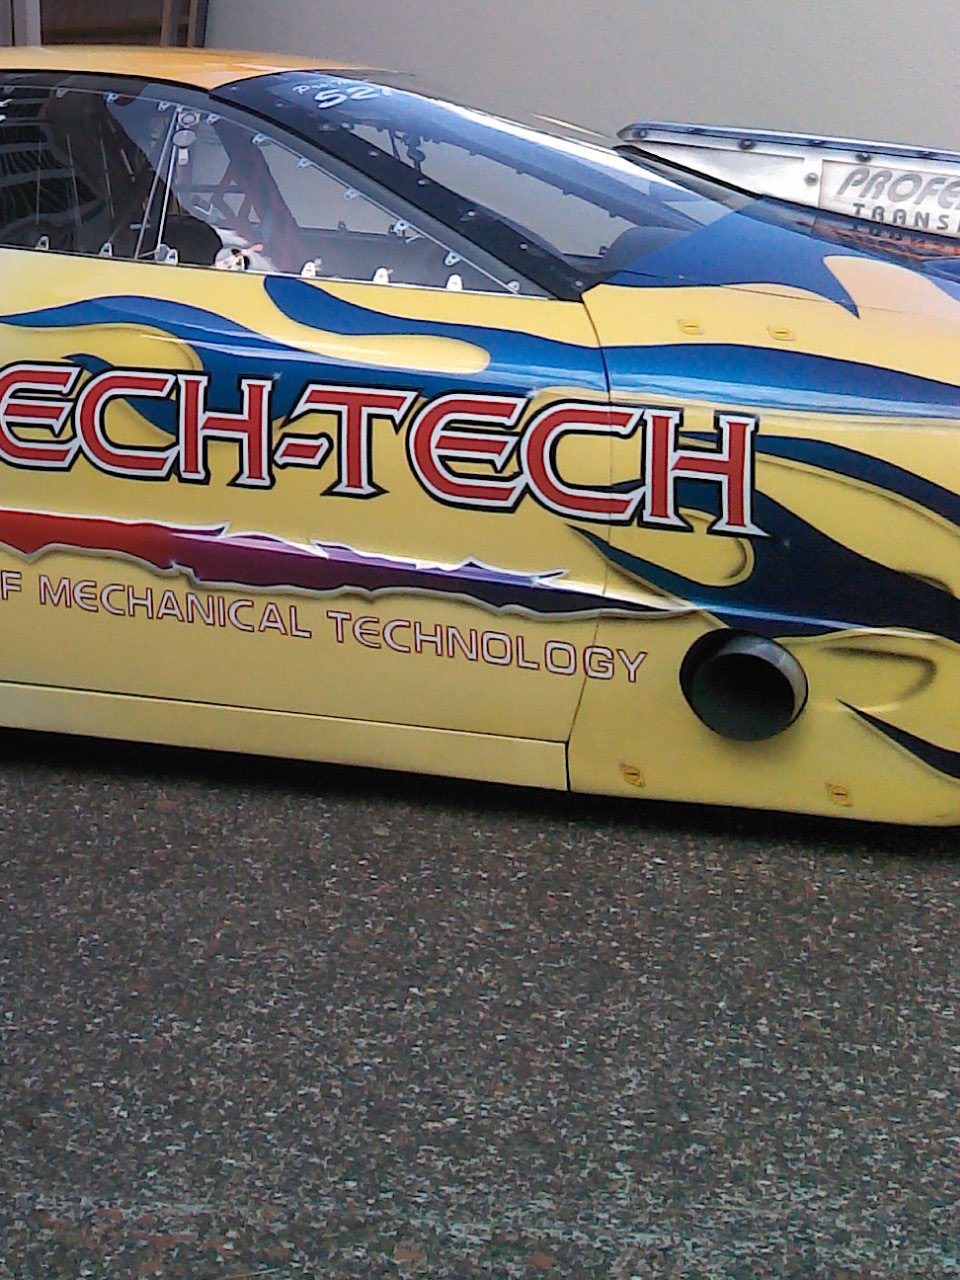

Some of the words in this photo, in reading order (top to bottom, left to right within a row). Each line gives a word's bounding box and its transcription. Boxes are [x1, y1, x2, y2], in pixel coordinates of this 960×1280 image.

[853, 202, 960, 232] TRANS
[39, 575, 312, 640] MECHANICAL
[326, 609, 648, 683] TECHNOLOGY
